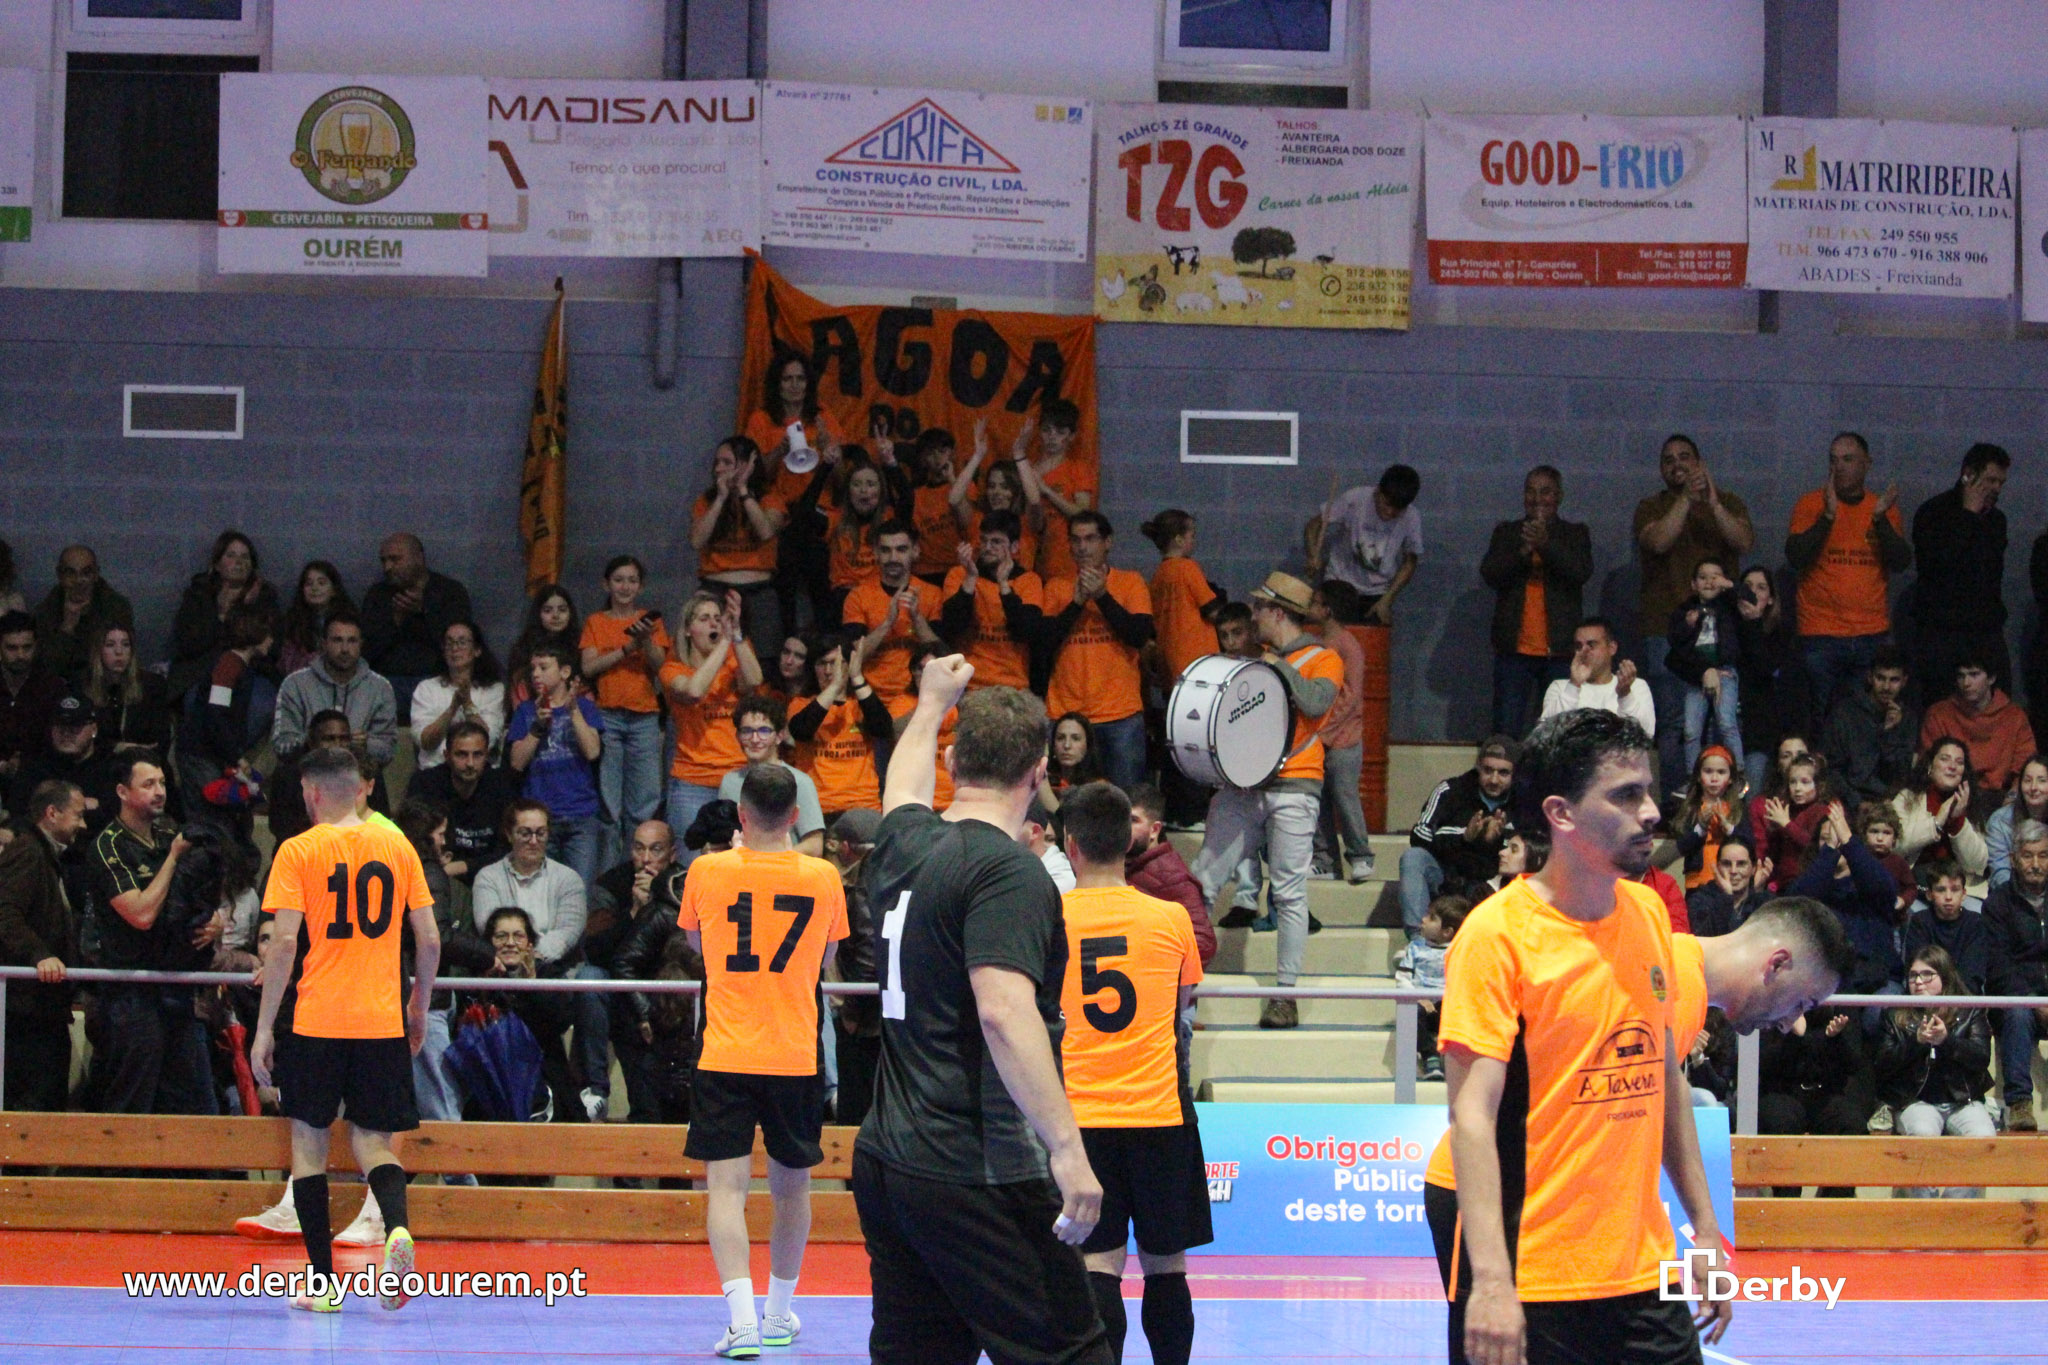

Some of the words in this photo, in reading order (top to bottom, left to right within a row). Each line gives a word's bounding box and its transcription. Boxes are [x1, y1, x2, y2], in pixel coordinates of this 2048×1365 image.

[329, 88, 383, 103] CERVEJARIA
[489, 94, 755, 124] MADISANU
[859, 106, 984, 165] CORIFA
[1117, 120, 1168, 146] TALHOS
[1173, 116, 1189, 131] ZÉ
[1193, 119, 1249, 151] GRANDE
[1282, 132, 1340, 143] AVANTEIRA
[1760, 130, 1774, 151] M
[1281, 143, 1350, 156] ALBERGARIA
[1352, 145, 1374, 156] DOS
[1376, 146, 1406, 157] DOZE
[1281, 155, 1344, 167] FREIXIANDA
[569, 162, 613, 175] Temos
[618, 166, 628, 175] o
[632, 165, 660, 177] que
[664, 161, 726, 176] procura!
[1480, 139, 1684, 189] GOOD-FRIO
[1784, 154, 1797, 175] R
[815, 168, 932, 189] CONSTRUÇÃO
[937, 176, 986, 192] CIVIL,
[992, 178, 1028, 193] LDA.
[1117, 138, 1248, 232] TZG
[1820, 161, 2013, 200] MATRIRIBEIRA
[826, 196, 859, 208] Compra
[868, 197, 893, 208] Venda
[1258, 196, 1301, 212] Carnes
[1307, 192, 1323, 207] da
[1327, 191, 1360, 205] nossa
[1367, 182, 1410, 198] Aldeia
[1515, 198, 1566, 209] Hoteleiros
[1753, 196, 1837, 212] MATERIAIS
[1840, 199, 1861, 212] DE
[1979, 206, 2013, 220] LDA.
[272, 213, 344, 226] CERVEJARIA
[355, 214, 434, 228] PETISQUEIRA
[303, 235, 403, 259] OURÉM
[701, 229, 743, 244] AEG
[1881, 228, 1905, 242] 249
[1908, 229, 1931, 244] 550
[1934, 230, 1959, 245] 955
[1440, 258, 1458, 269] Rua
[1817, 244, 1841, 258] 966
[1844, 245, 1869, 259] 473
[1873, 246, 1898, 260] 670
[1910, 247, 1934, 262] 916
[1938, 248, 1961, 263] 388
[1964, 249, 1989, 264] 906
[1552, 270, 1584, 281] Ourém
[1798, 266, 1872, 283] ABADES
[1887, 268, 1963, 288] Freixianda
[327, 860, 395, 941] 10
[725, 892, 815, 974] 17
[881, 890, 912, 1020] 1
[1080, 935, 1138, 1034] 5
[1579, 1075, 1598, 1098] A
[1603, 1073, 1656, 1096] Tavern
[1266, 1134, 1424, 1168] Obrigado
[1334, 1166, 1425, 1192] Públic
[1284, 1198, 1367, 1222] deste
